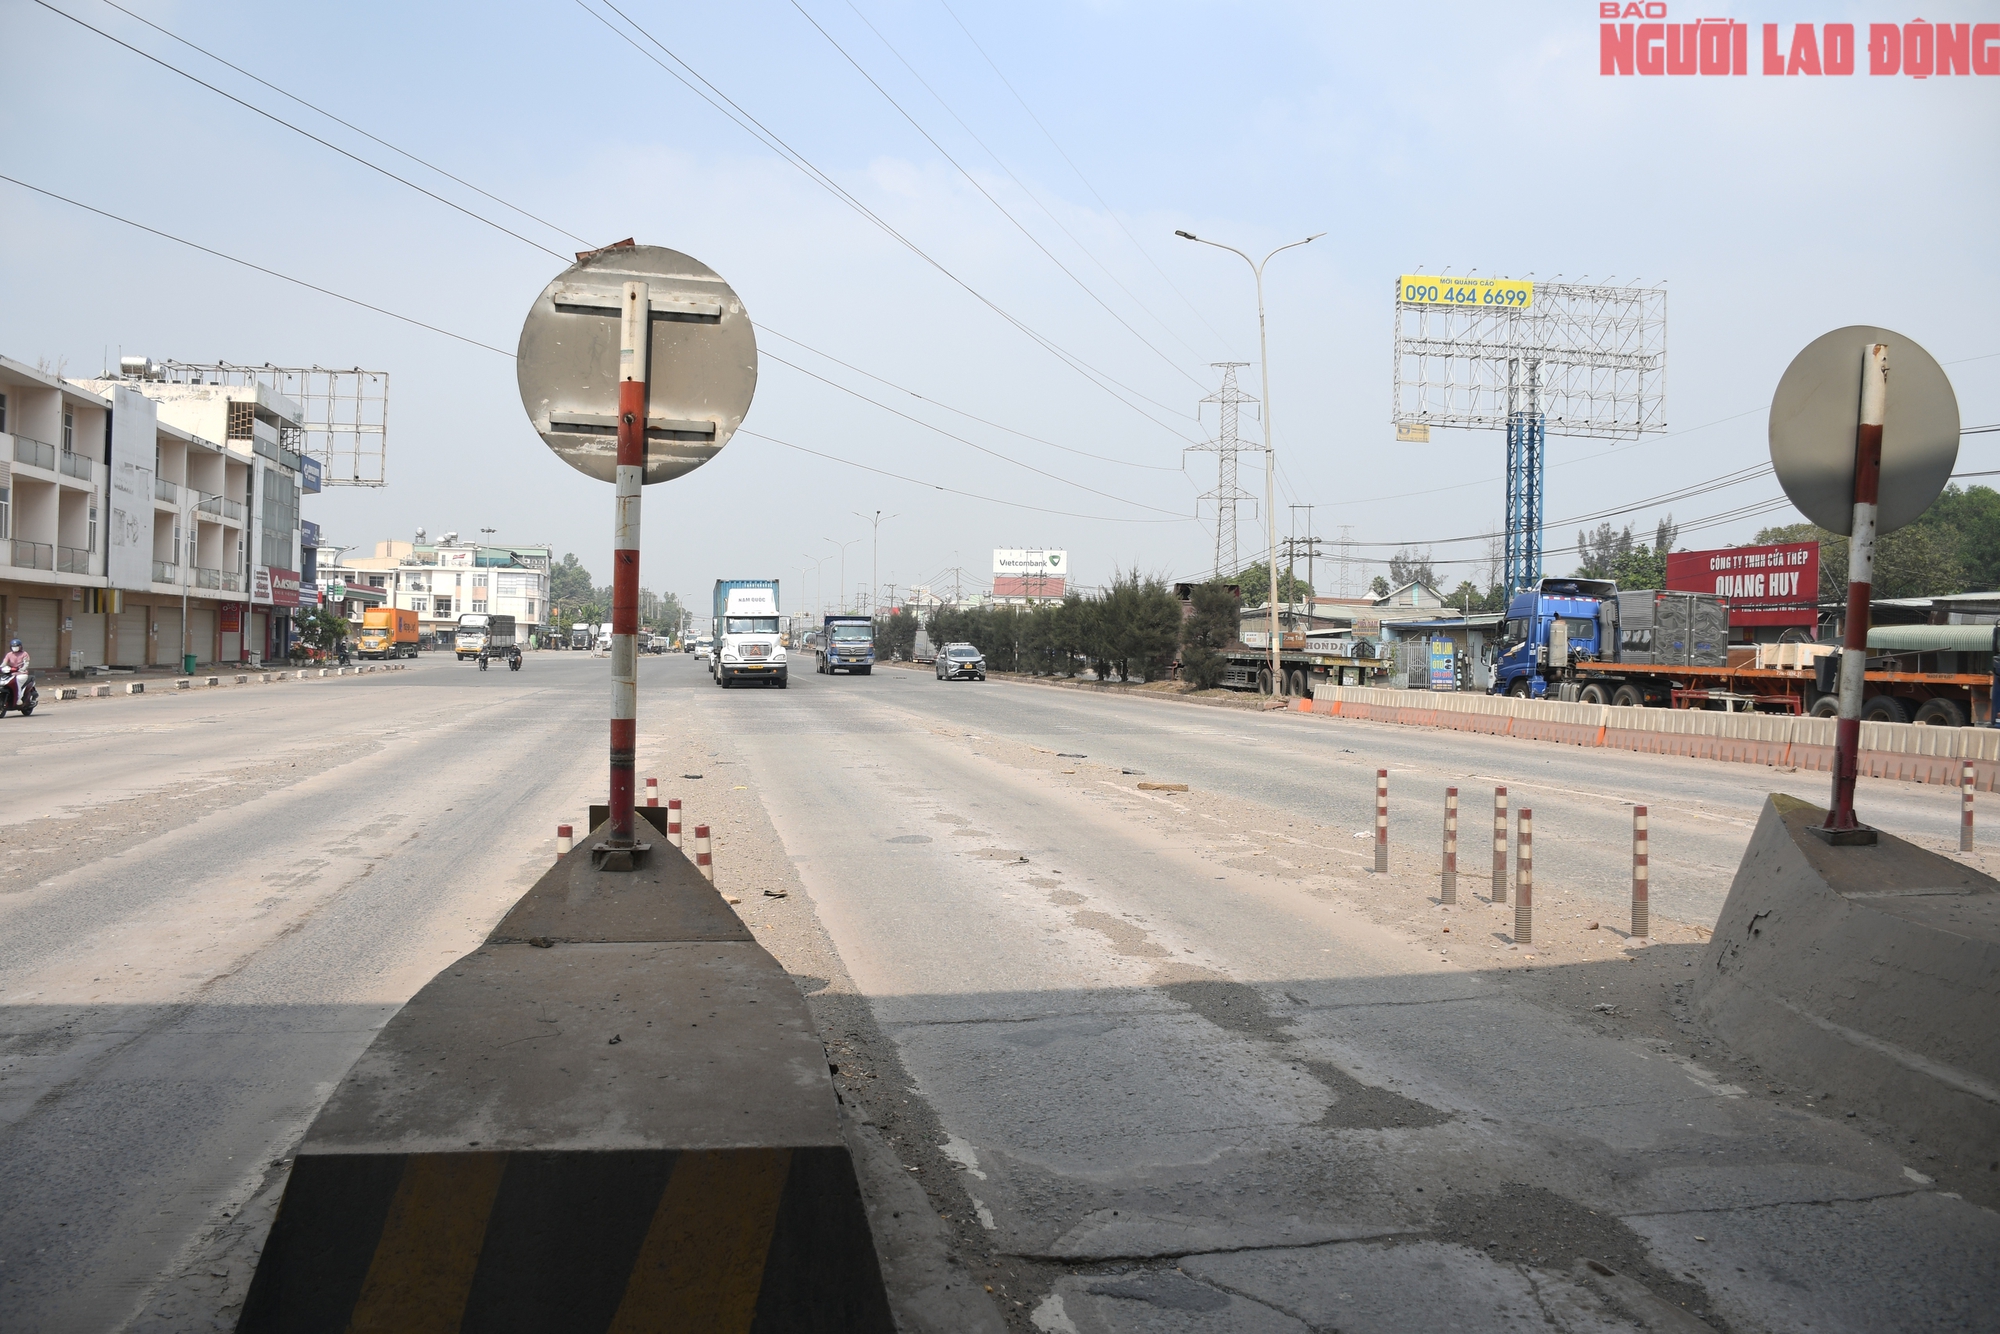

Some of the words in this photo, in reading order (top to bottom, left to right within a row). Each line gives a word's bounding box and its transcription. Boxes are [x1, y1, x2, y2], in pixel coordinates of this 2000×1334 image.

[1454, 278, 1478, 287] QUẢNG
[1480, 279, 1495, 287] CÁO
[1406, 284, 1438, 302] 090
[1444, 286, 1477, 304] 464
[1483, 288, 1527, 306] 6699
[999, 559, 1048, 567] Vietcombank
[1710, 554, 1731, 571] CÔNG
[1733, 555, 1743, 569] TY
[1744, 554, 1766, 568] TNHH
[1767, 548, 1784, 567] CỬA
[1787, 549, 1808, 565] THÉP
[1716, 573, 1764, 597] QUANG
[1769, 571, 1800, 597] HUY
[1306, 641, 1347, 651] HONDA
